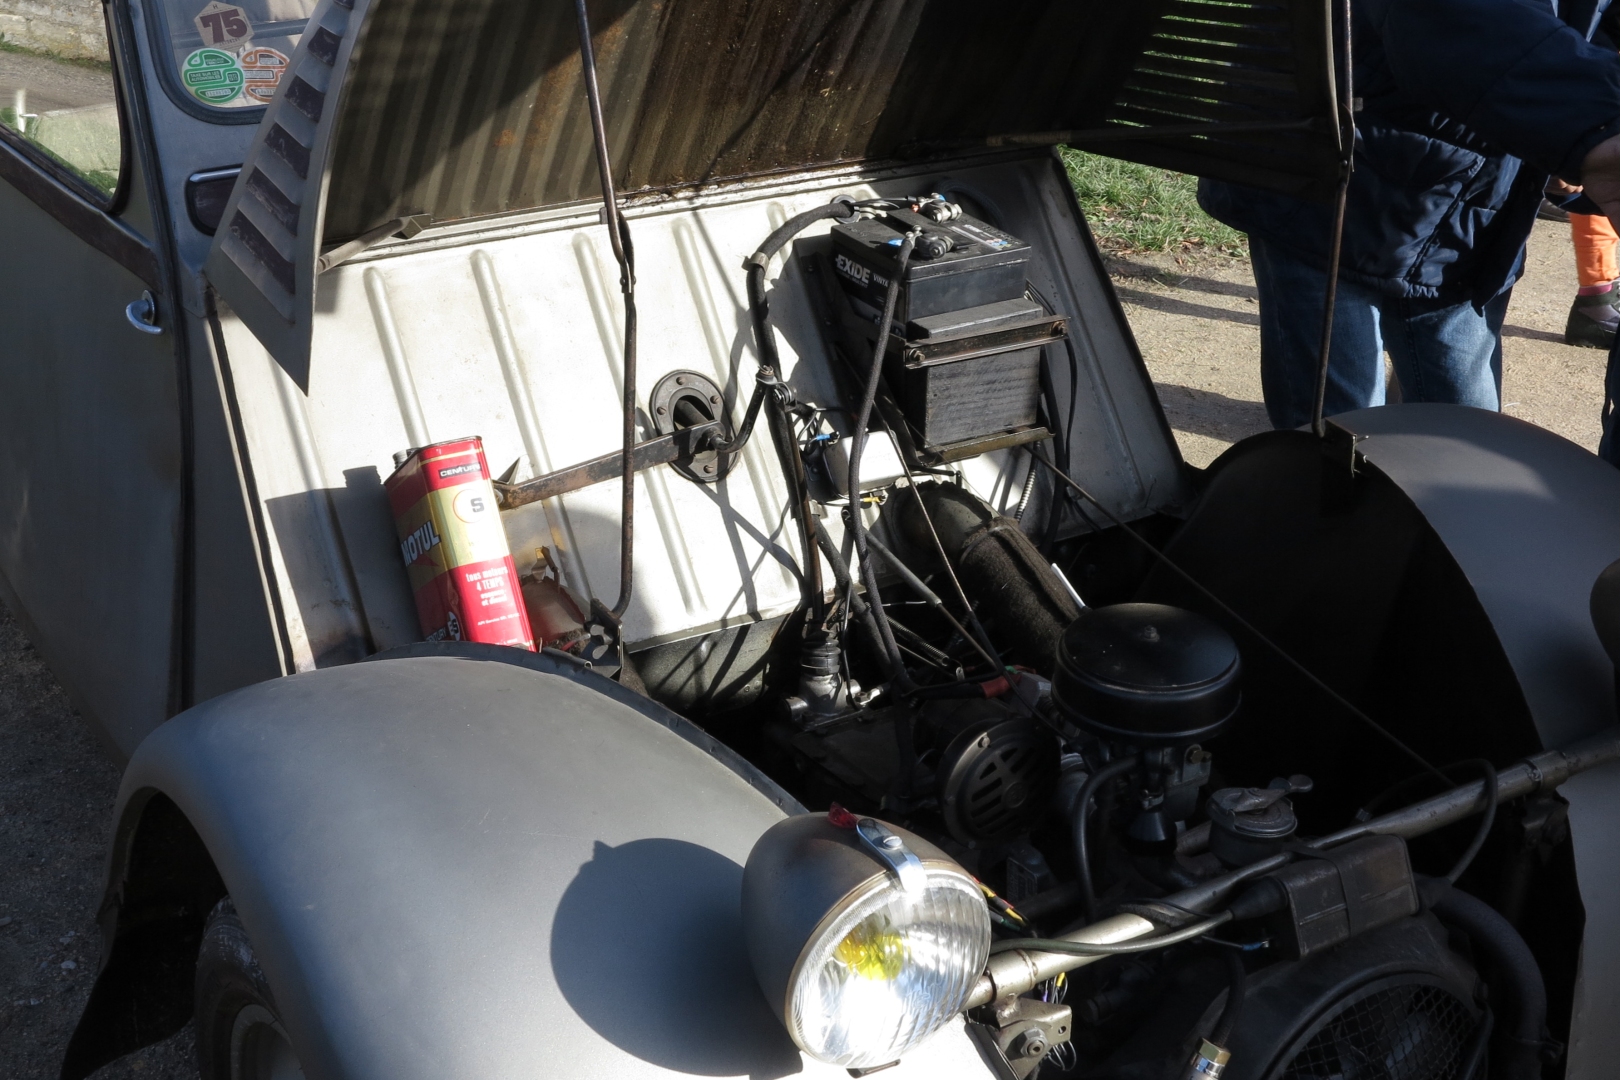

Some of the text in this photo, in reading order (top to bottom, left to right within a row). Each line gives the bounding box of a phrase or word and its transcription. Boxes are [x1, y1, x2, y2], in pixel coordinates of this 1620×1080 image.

[200, 9, 248, 44] 75
[440, 463, 481, 478] CENTURY
[470, 497, 485, 513] S
[401, 520, 441, 567] MOTUL
[476, 576, 505, 591] 4 TEMPS
